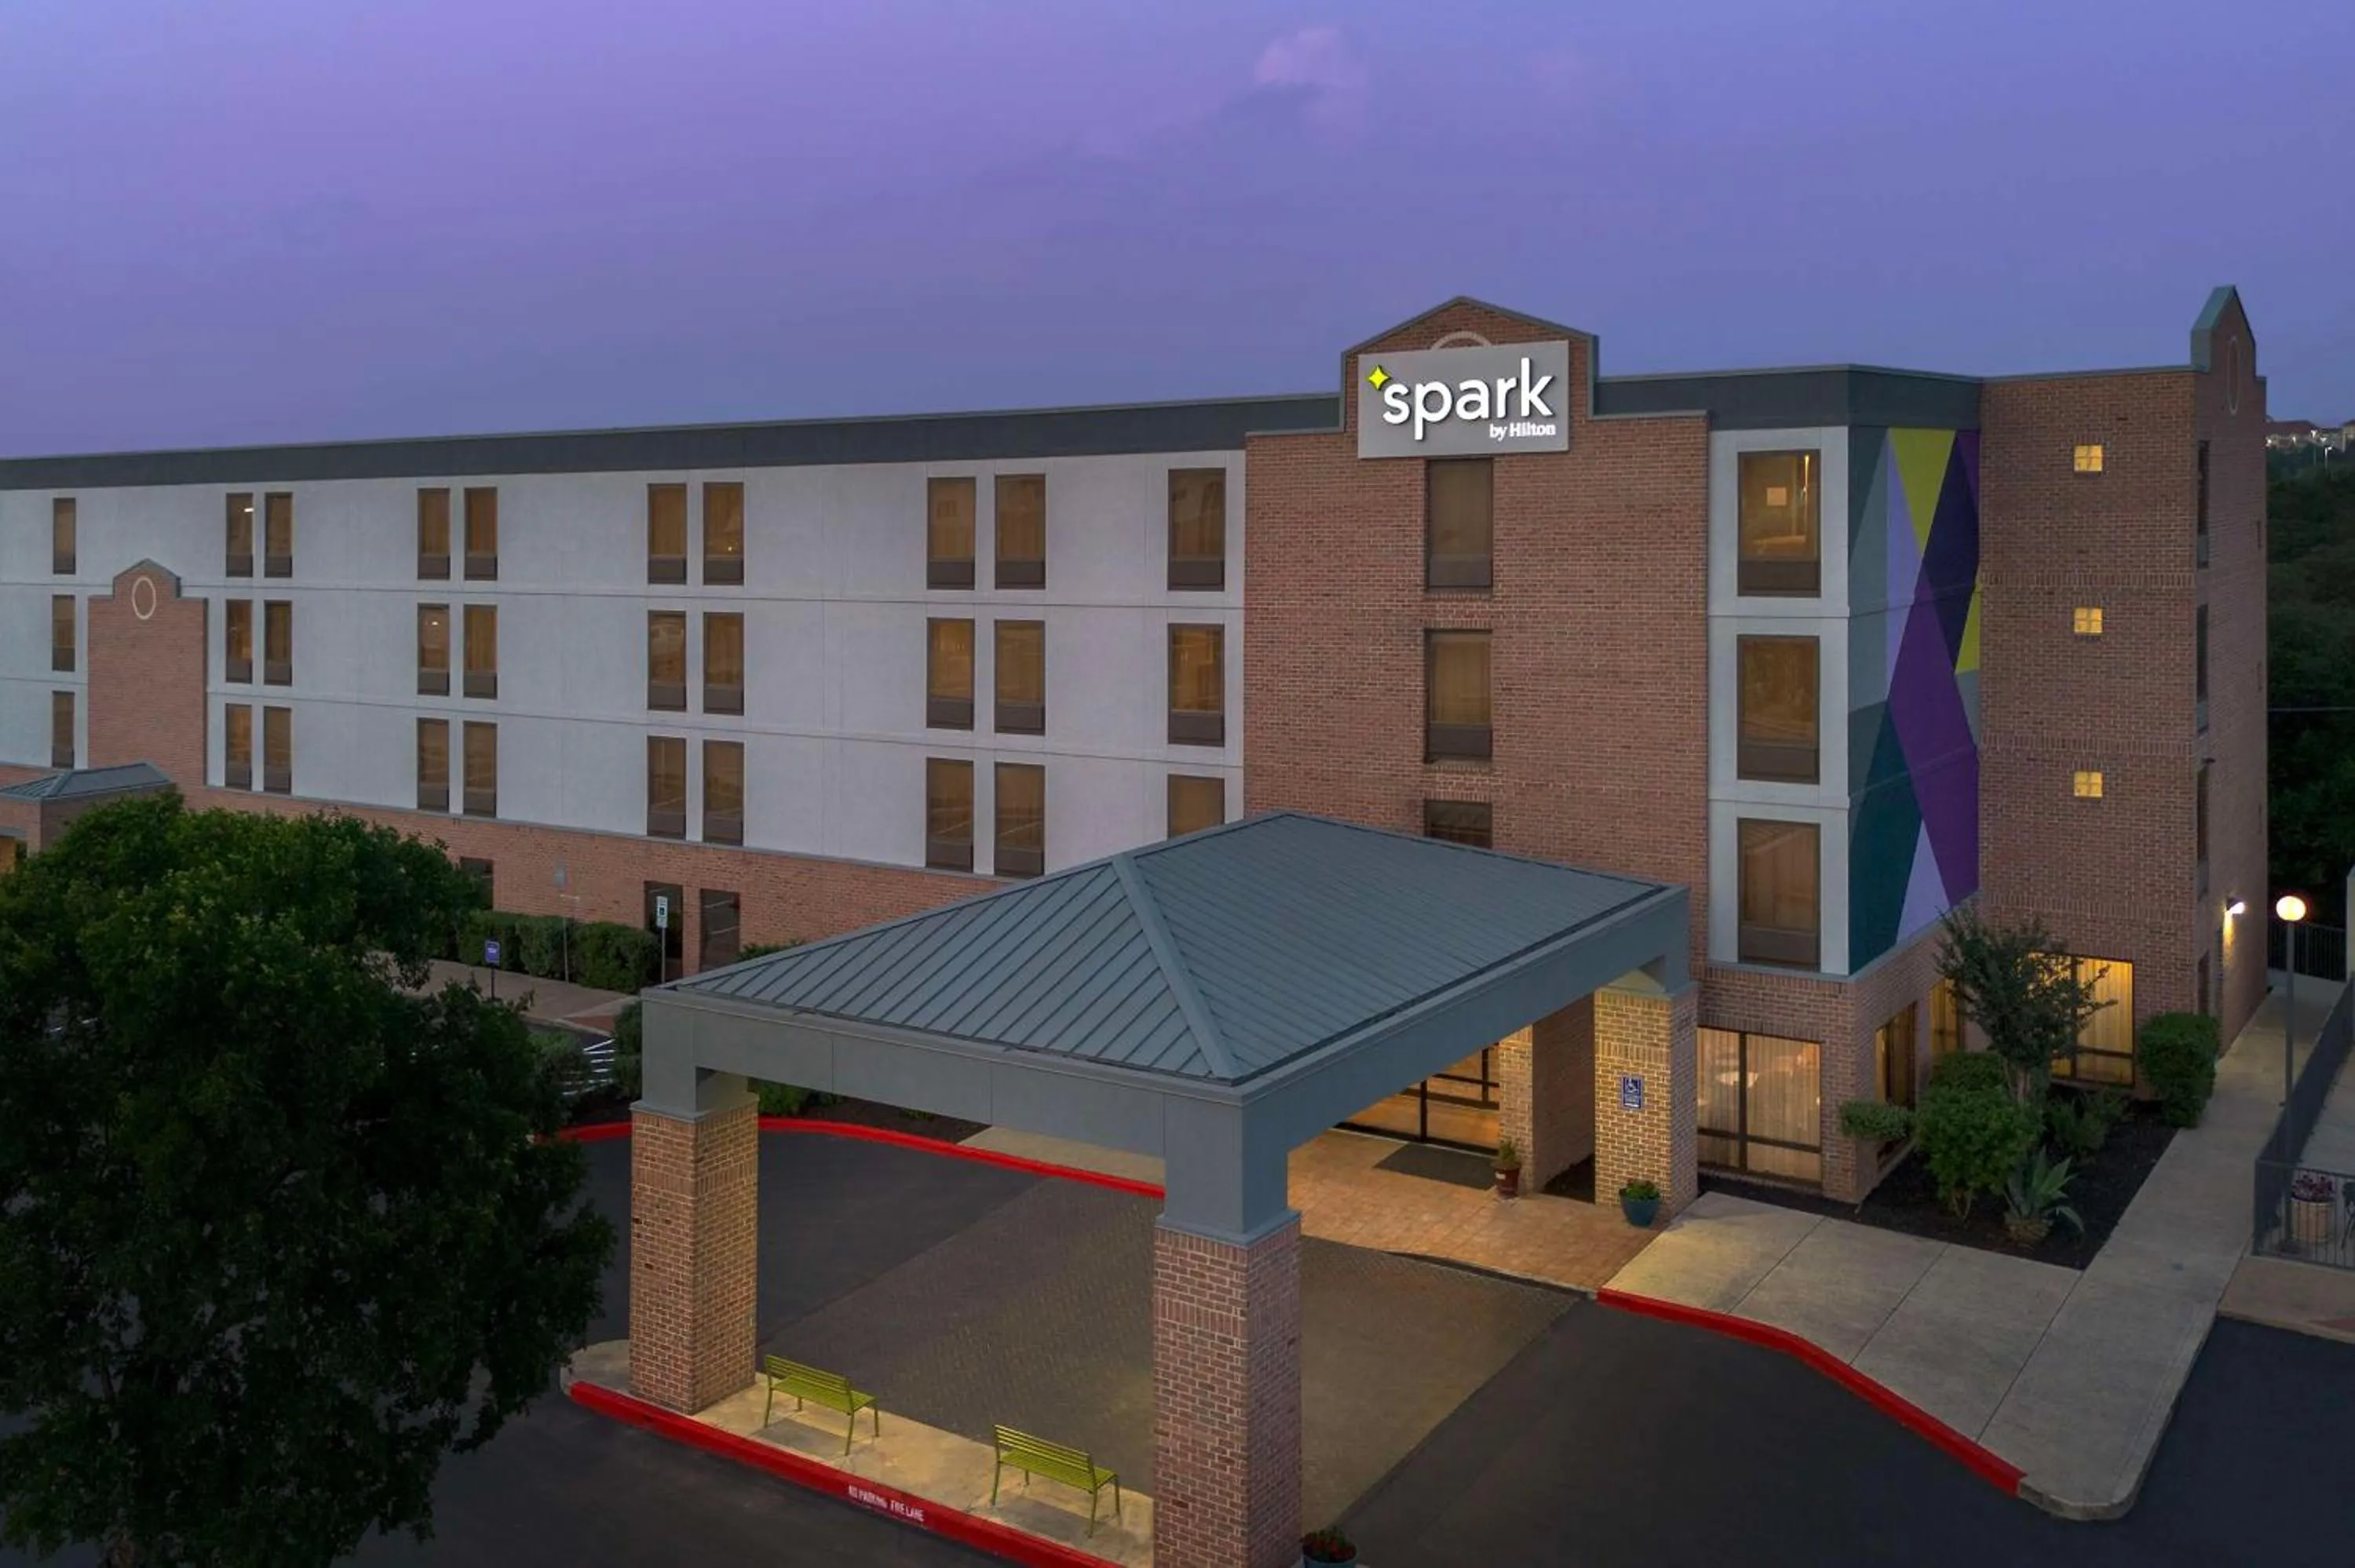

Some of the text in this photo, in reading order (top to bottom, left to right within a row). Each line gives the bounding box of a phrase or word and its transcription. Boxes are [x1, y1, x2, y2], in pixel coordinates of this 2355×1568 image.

[1382, 357, 1555, 440] spark
[1489, 421, 1556, 442] by Hilton
